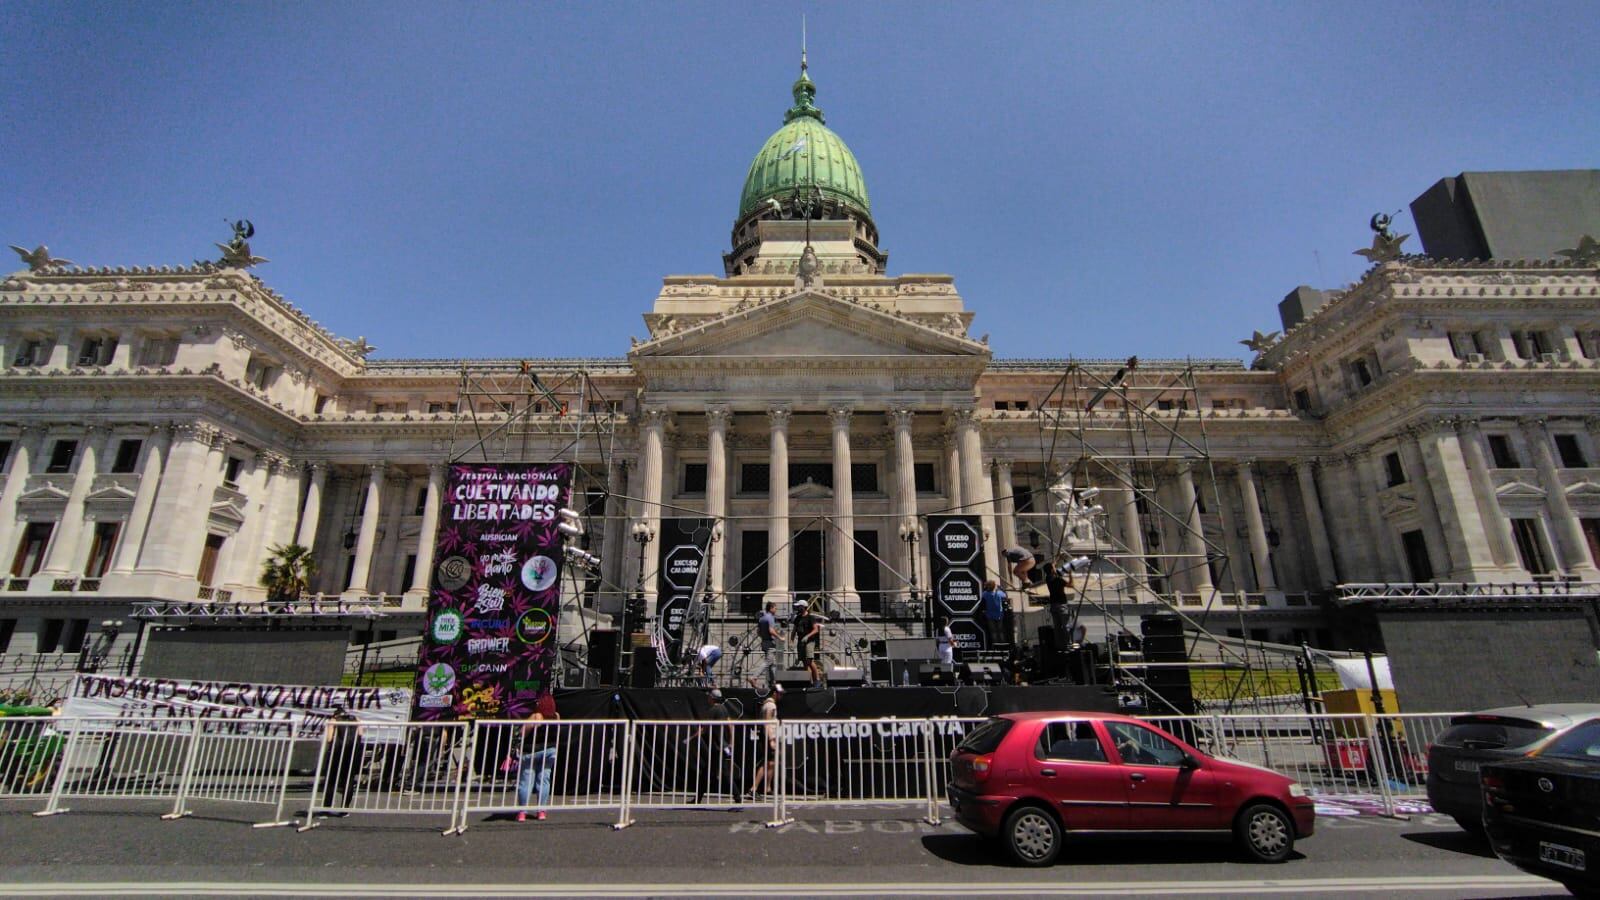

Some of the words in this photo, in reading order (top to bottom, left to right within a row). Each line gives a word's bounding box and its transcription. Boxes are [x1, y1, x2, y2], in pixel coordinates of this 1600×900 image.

[455, 484, 559, 500] CULTIVANDO
[453, 504, 555, 520] LIBERTADES
[438, 624, 455, 632] MIX
